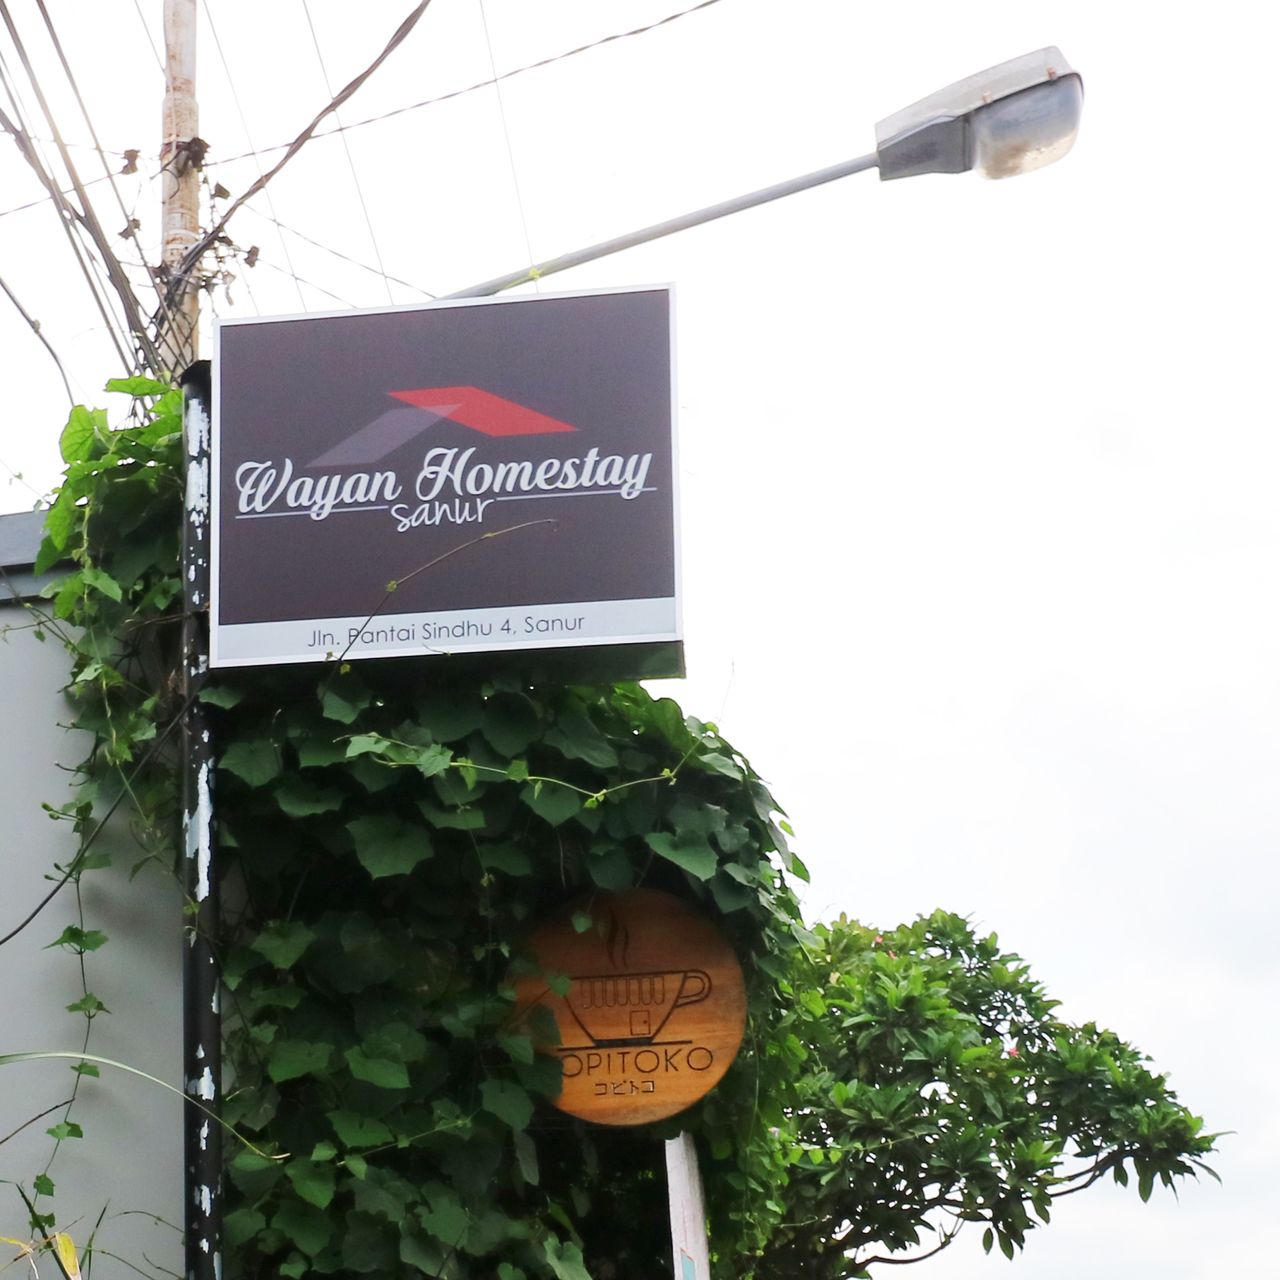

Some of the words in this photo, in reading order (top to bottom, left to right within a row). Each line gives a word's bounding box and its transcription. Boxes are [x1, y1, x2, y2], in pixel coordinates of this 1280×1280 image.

[234, 458, 402, 521] Wayan
[414, 446, 654, 499] Homestay
[390, 497, 495, 533] sanur
[308, 629, 341, 648] Jln.
[348, 623, 416, 647] Pantai
[421, 620, 493, 640] Sindhu
[500, 618, 517, 636] 4,
[523, 615, 585, 634] Sanur
[562, 1046, 714, 1078] OPITOKO
